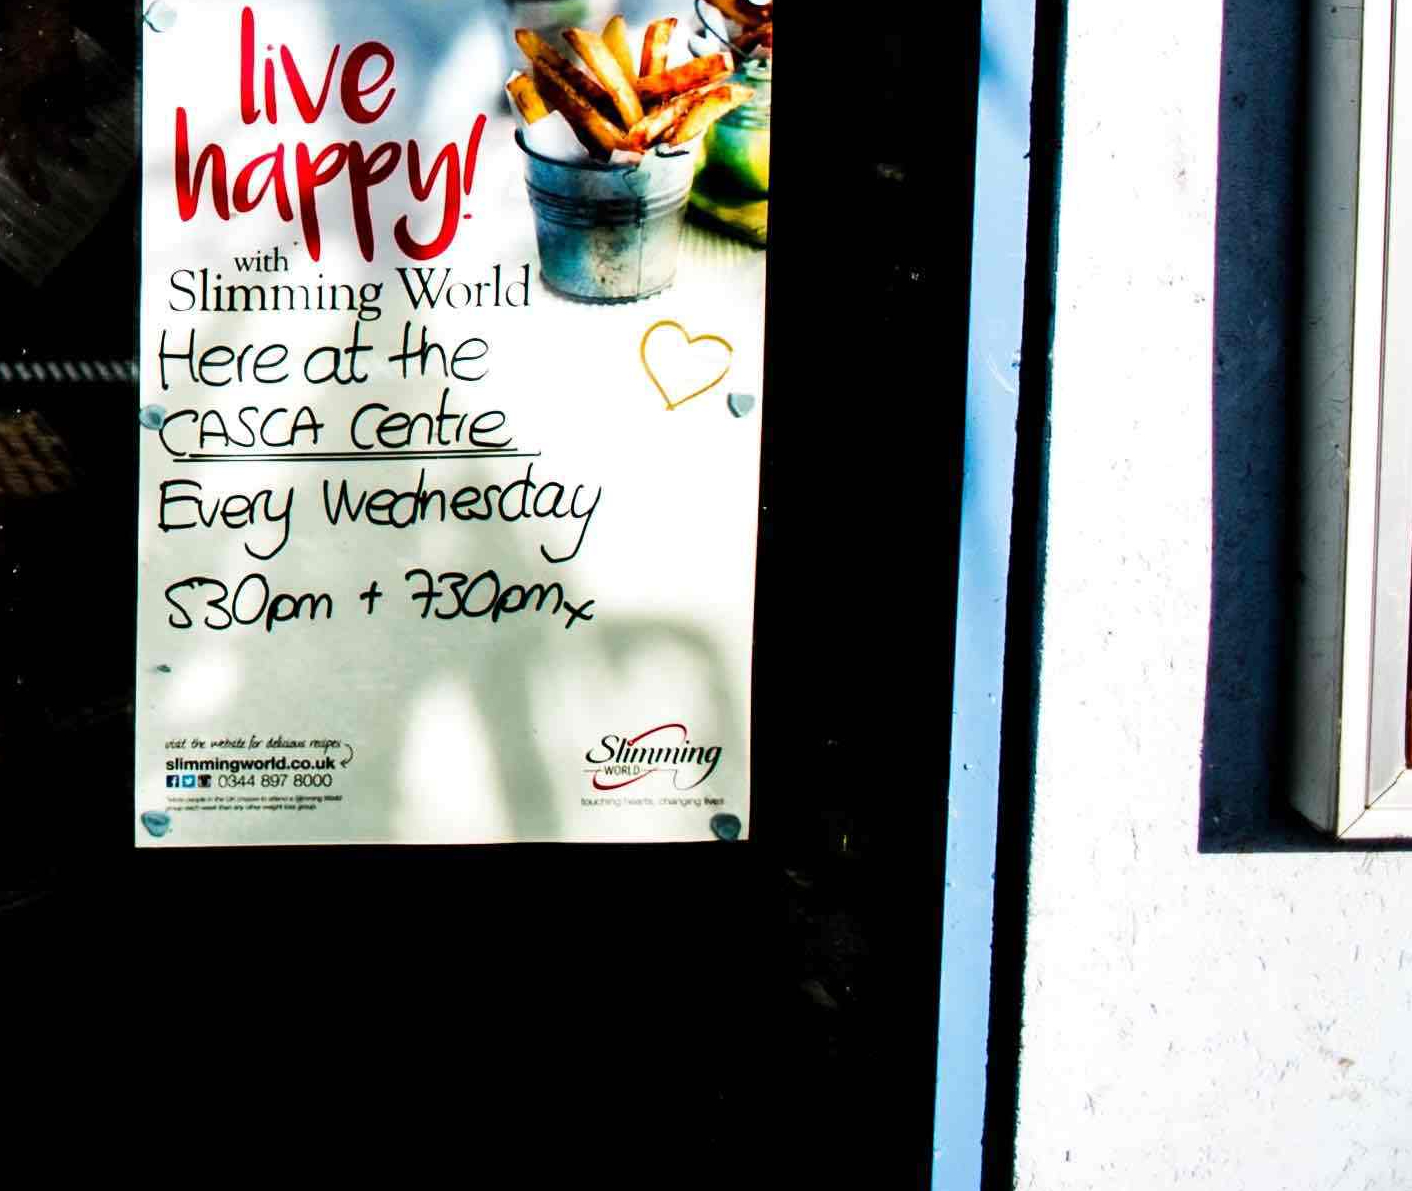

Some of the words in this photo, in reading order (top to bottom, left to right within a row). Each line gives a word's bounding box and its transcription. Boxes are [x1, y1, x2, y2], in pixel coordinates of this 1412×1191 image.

[240, 6, 396, 124] live
[176, 107, 486, 262] happy!
[234, 247, 289, 272] with
[169, 270, 382, 321] Slimming
[396, 263, 531, 310] World
[158, 328, 287, 390] Here
[304, 320, 374, 384] at
[389, 320, 489, 381] the
[158, 405, 324, 456] CASCA
[351, 388, 514, 451] Centre
[157, 478, 294, 560] Every
[324, 462, 602, 564] Wednesday
[165, 572, 333, 631] 530pm
[166, 757, 335, 772] slimmingworld.co.uk
[218, 774, 255, 788] 0344
[261, 774, 287, 788] 897
[293, 774, 332, 788] 8000
[586, 735, 722, 790] Slimming
